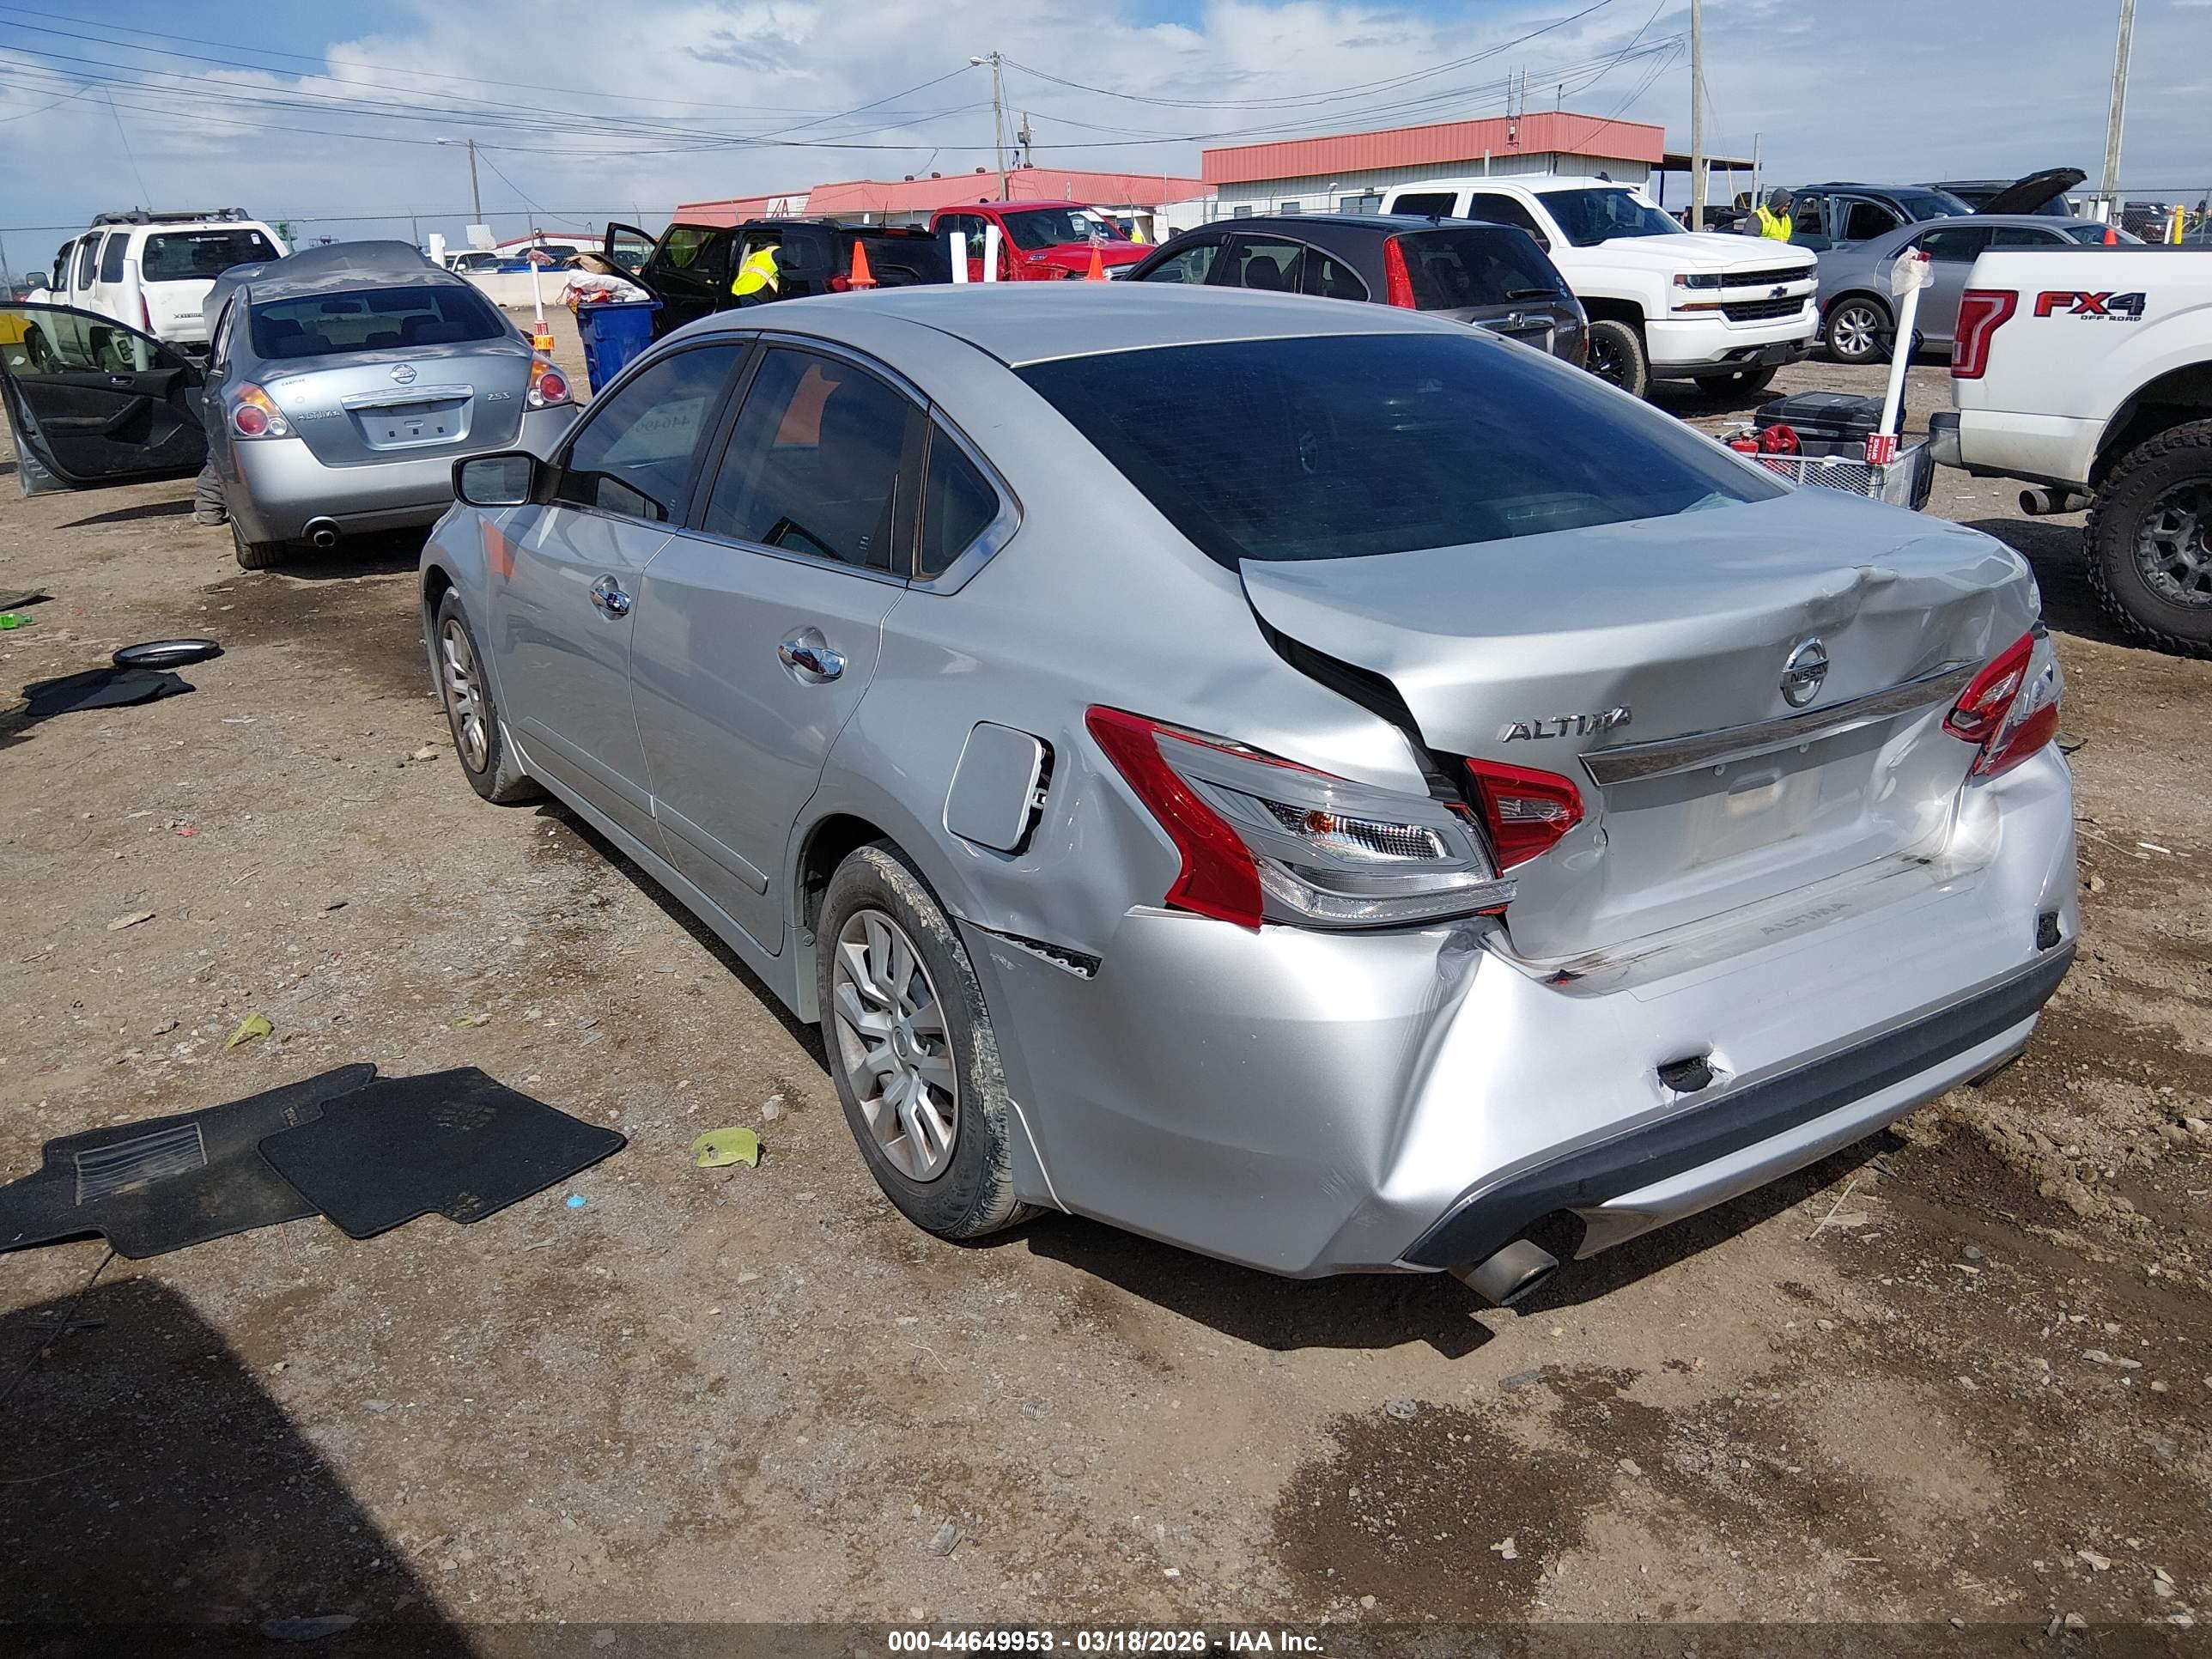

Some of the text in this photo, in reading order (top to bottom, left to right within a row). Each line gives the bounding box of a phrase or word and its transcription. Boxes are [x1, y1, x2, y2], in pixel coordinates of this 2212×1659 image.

[2033, 290, 2147, 318] FX4
[1871, 438, 1880, 460] OFFICE
[1790, 663, 1828, 684] NISSAN
[1498, 704, 1632, 744] ALTIMA
[1759, 902, 1853, 935] ALTIMA
